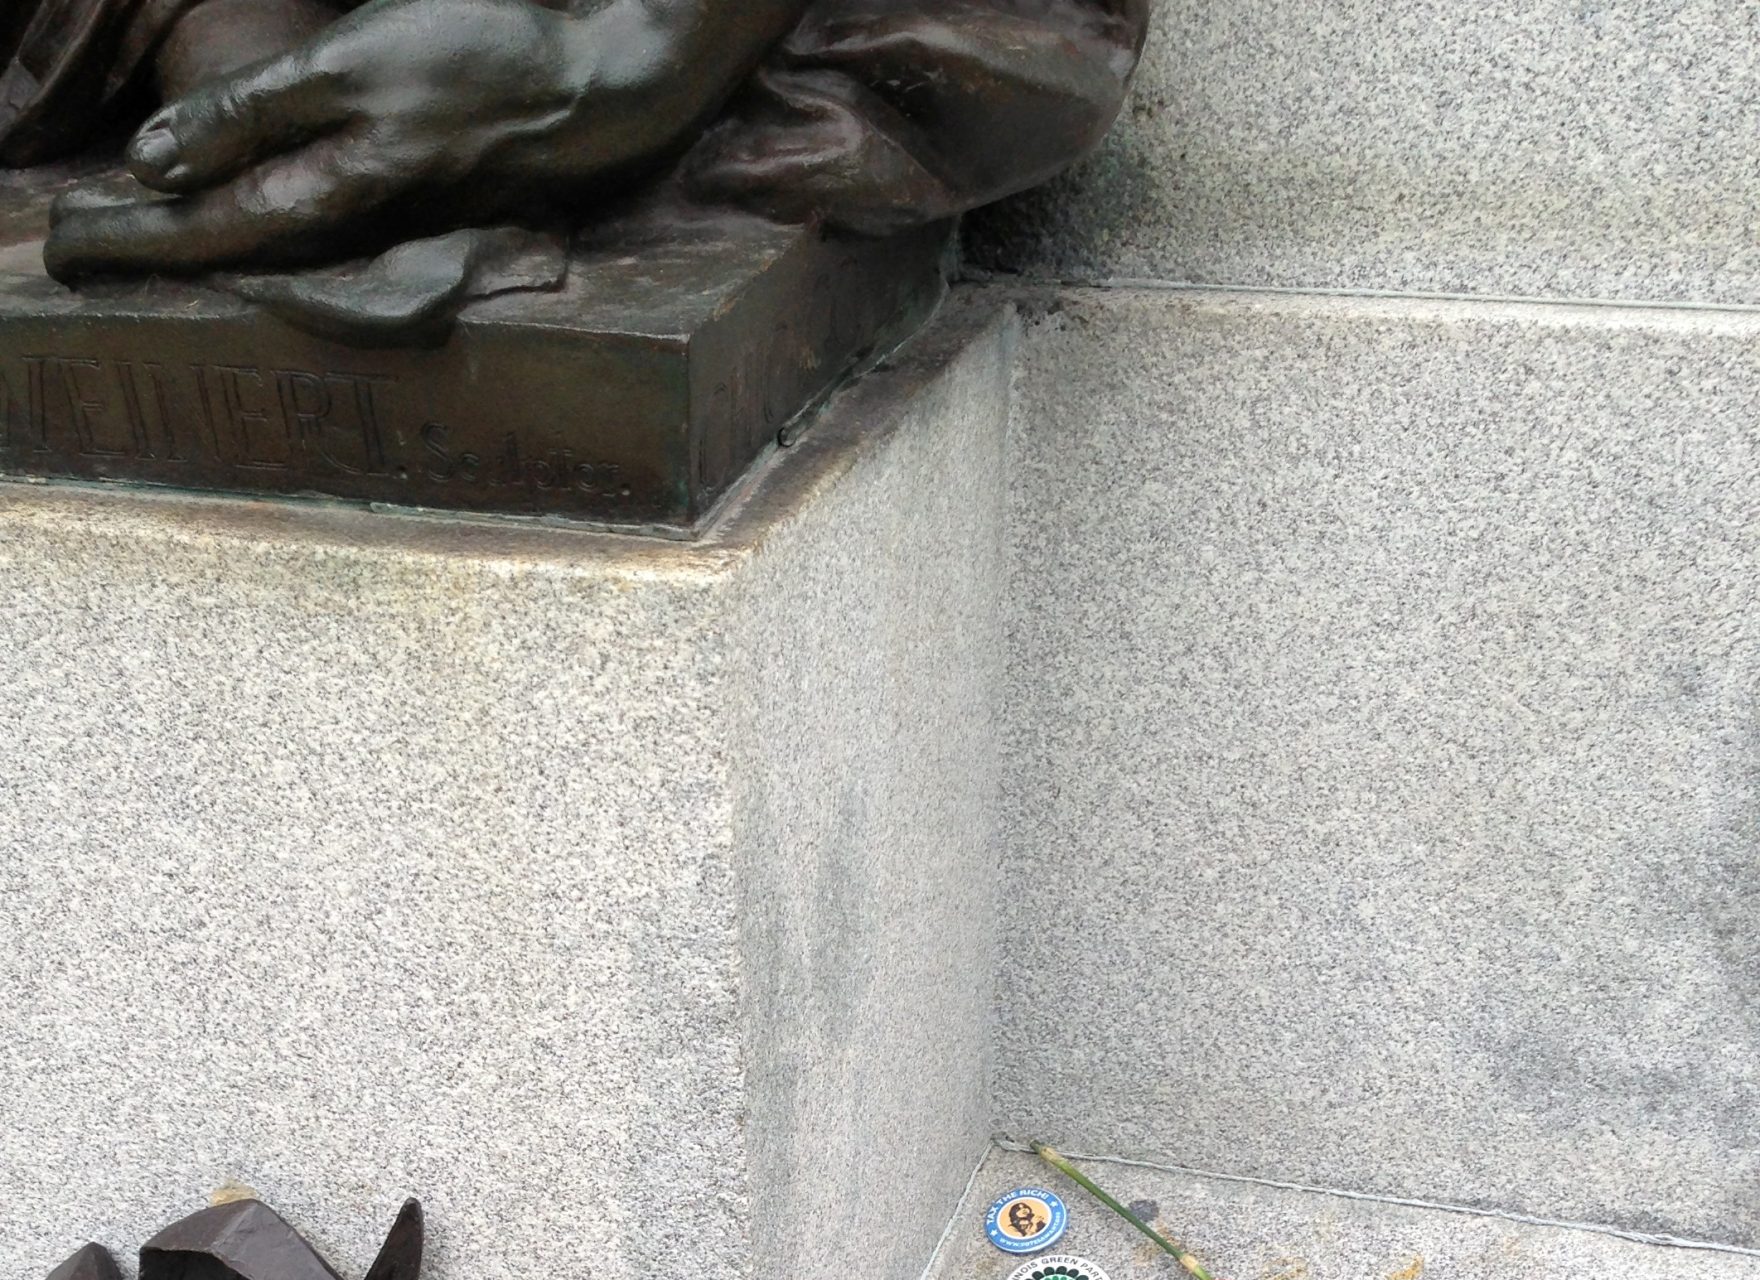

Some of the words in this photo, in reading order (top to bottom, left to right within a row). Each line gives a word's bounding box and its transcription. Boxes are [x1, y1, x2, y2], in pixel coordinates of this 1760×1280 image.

[987, 1206, 999, 1225] TAX
[996, 1191, 1017, 1205] THE
[1019, 1189, 1050, 1200] RICH!
[1041, 1256, 1079, 1265] GREEN
